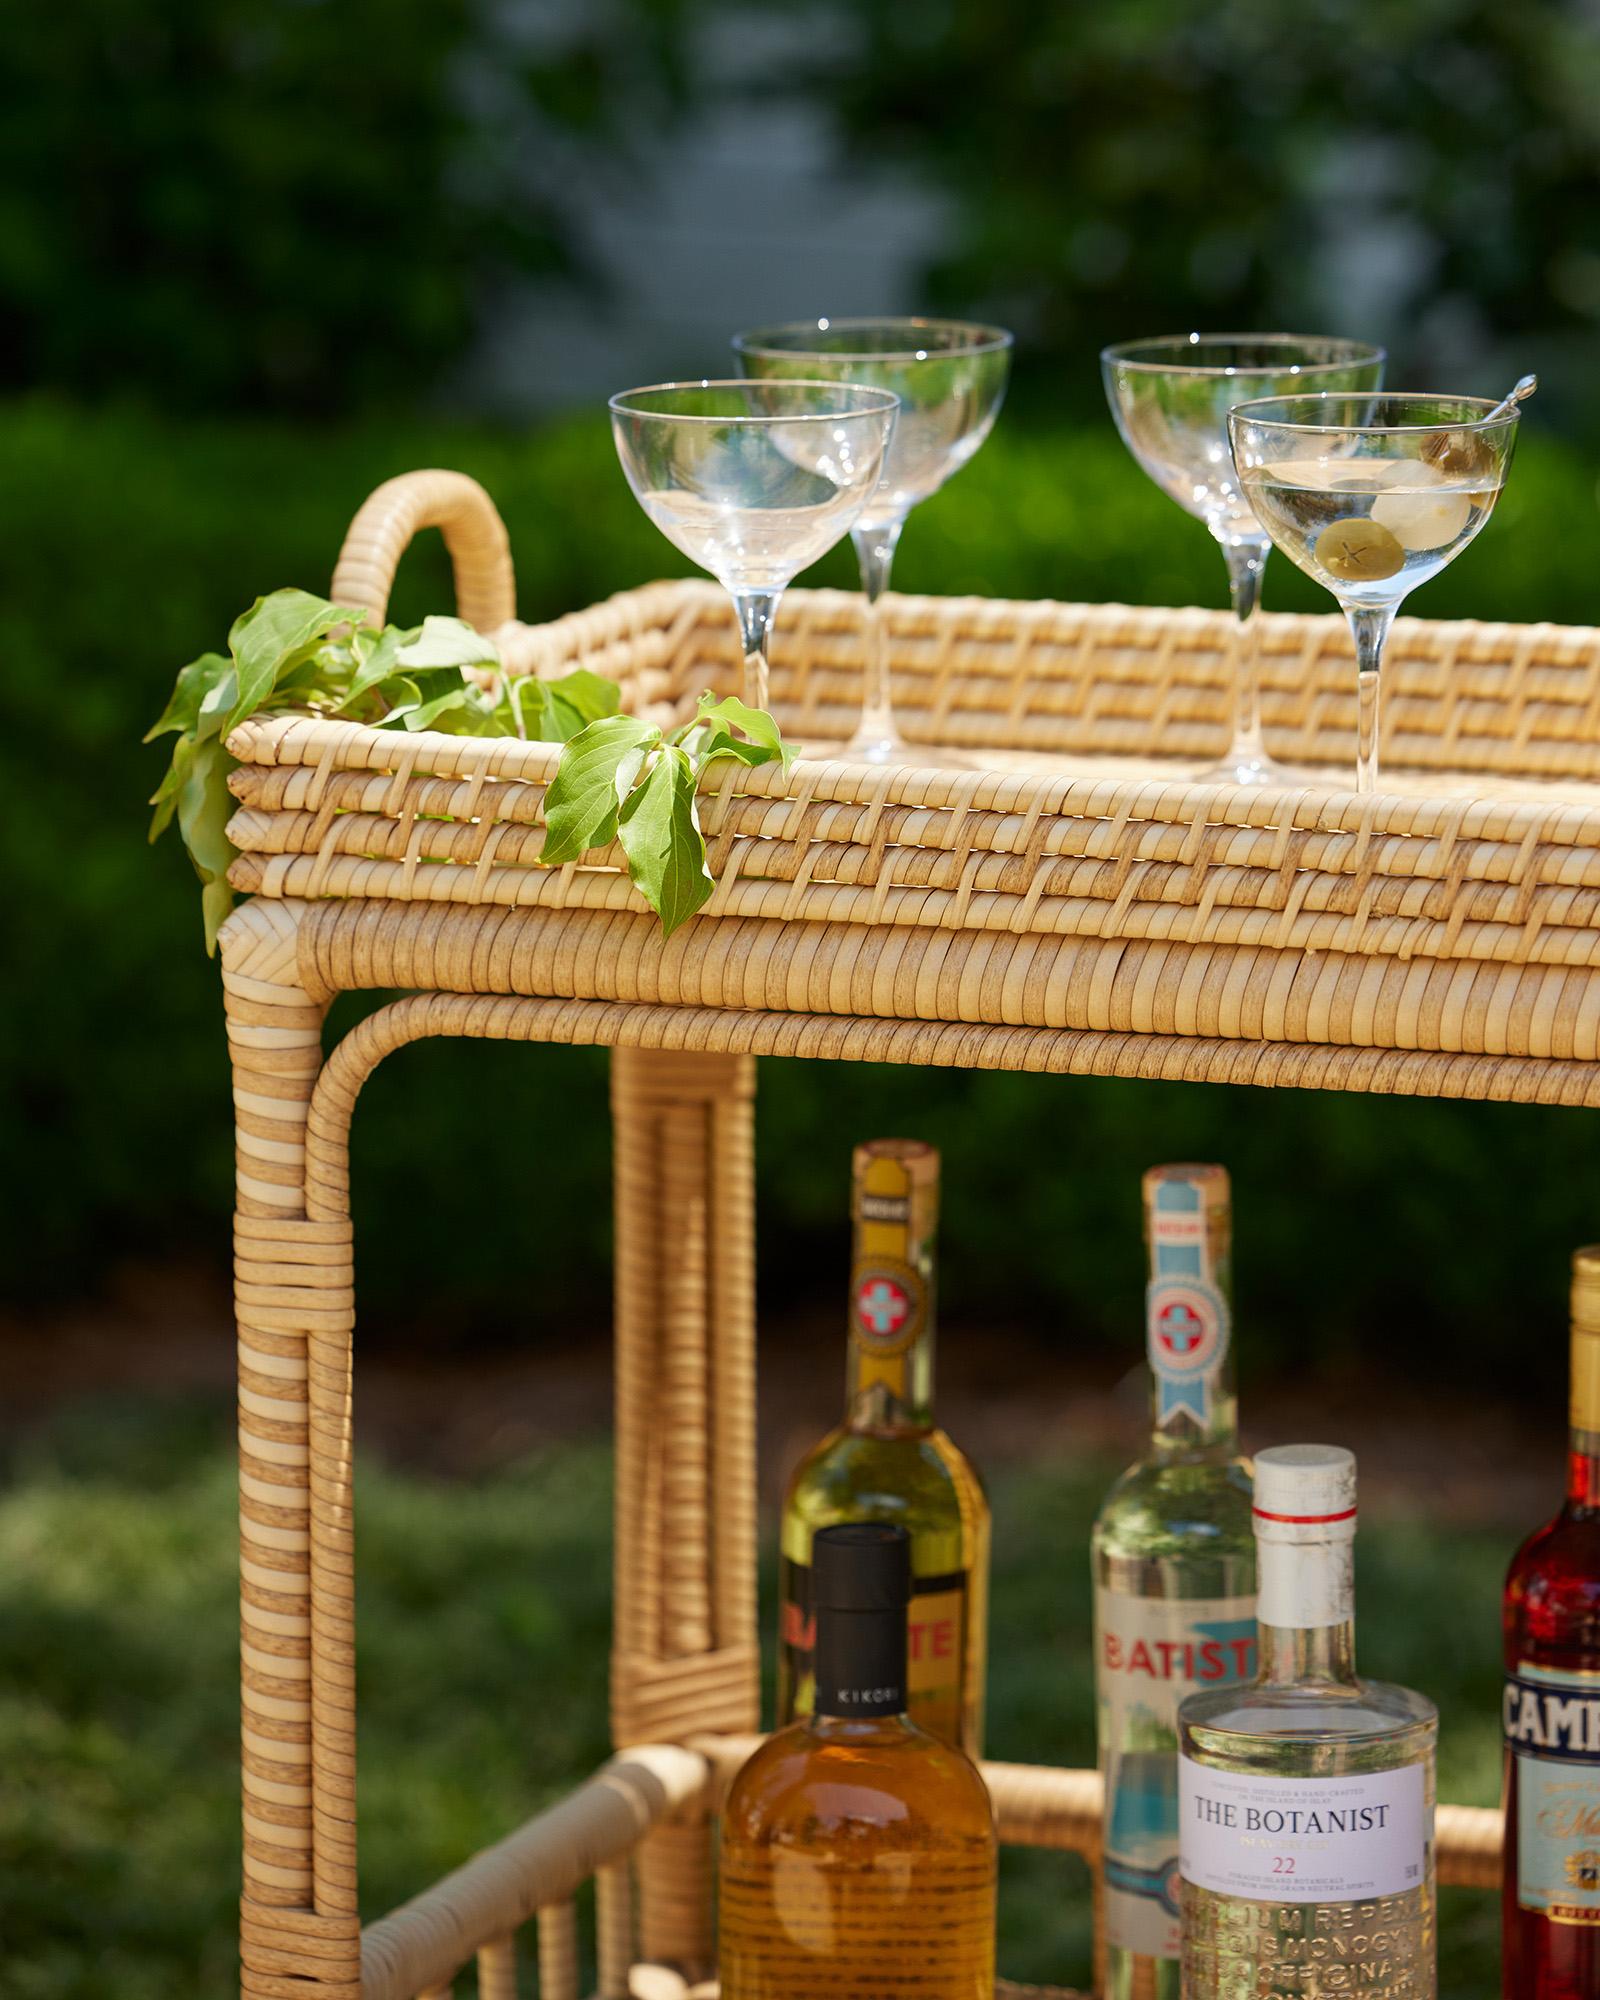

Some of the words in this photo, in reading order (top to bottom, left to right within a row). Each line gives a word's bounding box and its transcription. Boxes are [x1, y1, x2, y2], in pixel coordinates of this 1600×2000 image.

[1103, 1633, 1257, 1681] BATIST
[1194, 1795, 1237, 1828] THE
[1245, 1804, 1390, 1834] BOTANIST
[1272, 1856, 1296, 1874] 22
